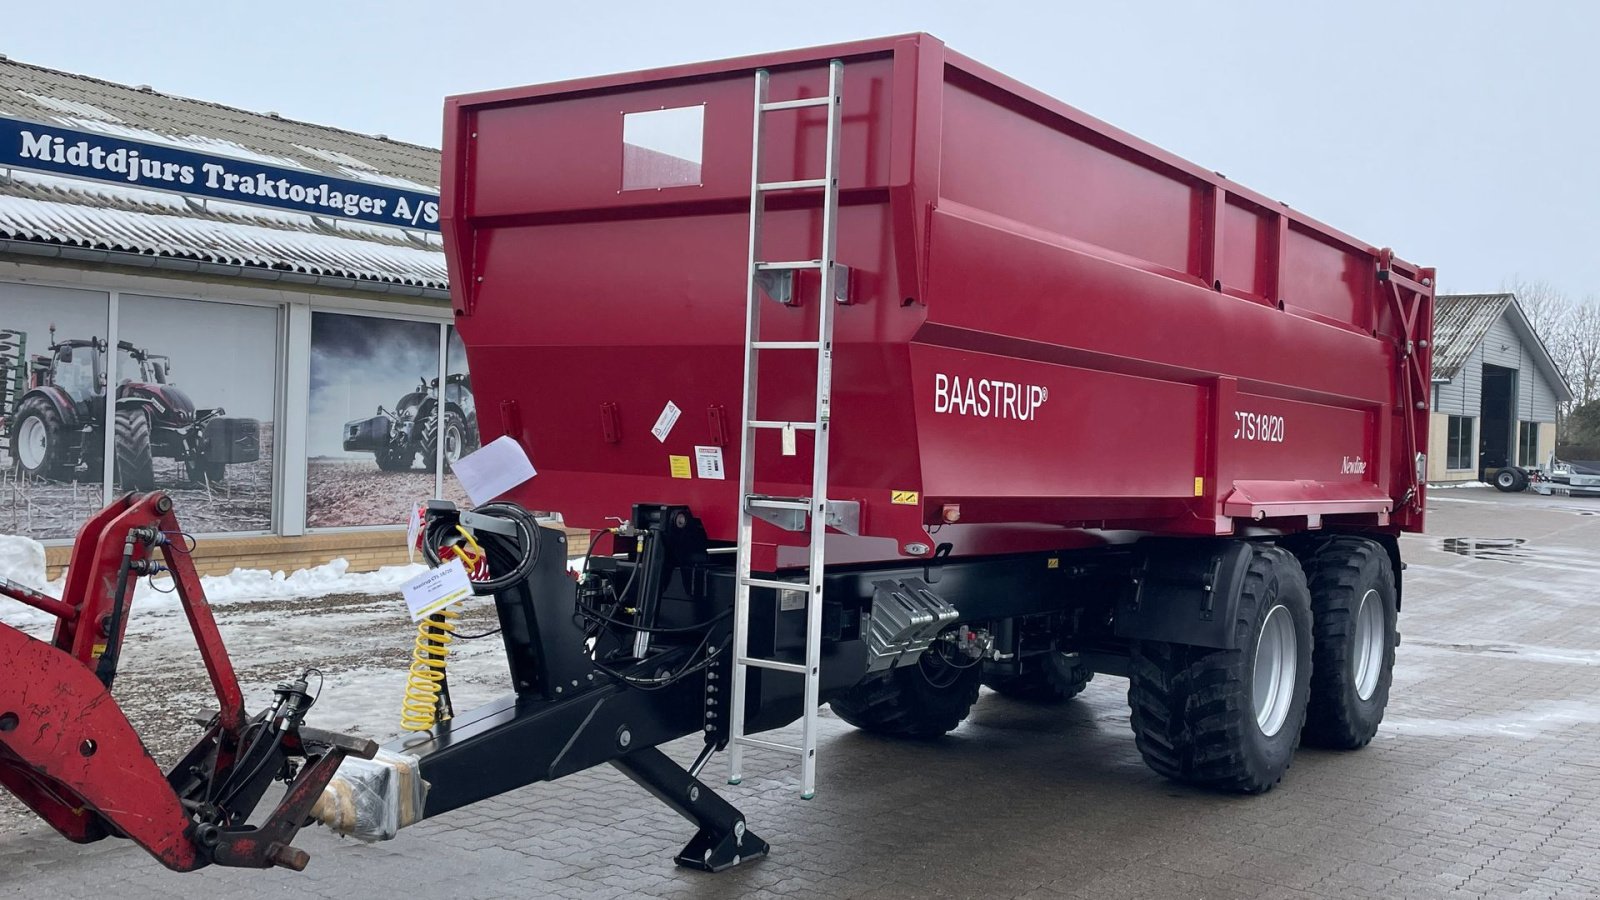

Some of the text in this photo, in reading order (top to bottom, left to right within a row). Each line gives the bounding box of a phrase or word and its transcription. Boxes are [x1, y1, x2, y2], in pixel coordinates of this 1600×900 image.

[19, 130, 439, 226] Midtdjurs Traktorlager A/S
[1340, 456, 1367, 474] Newline
